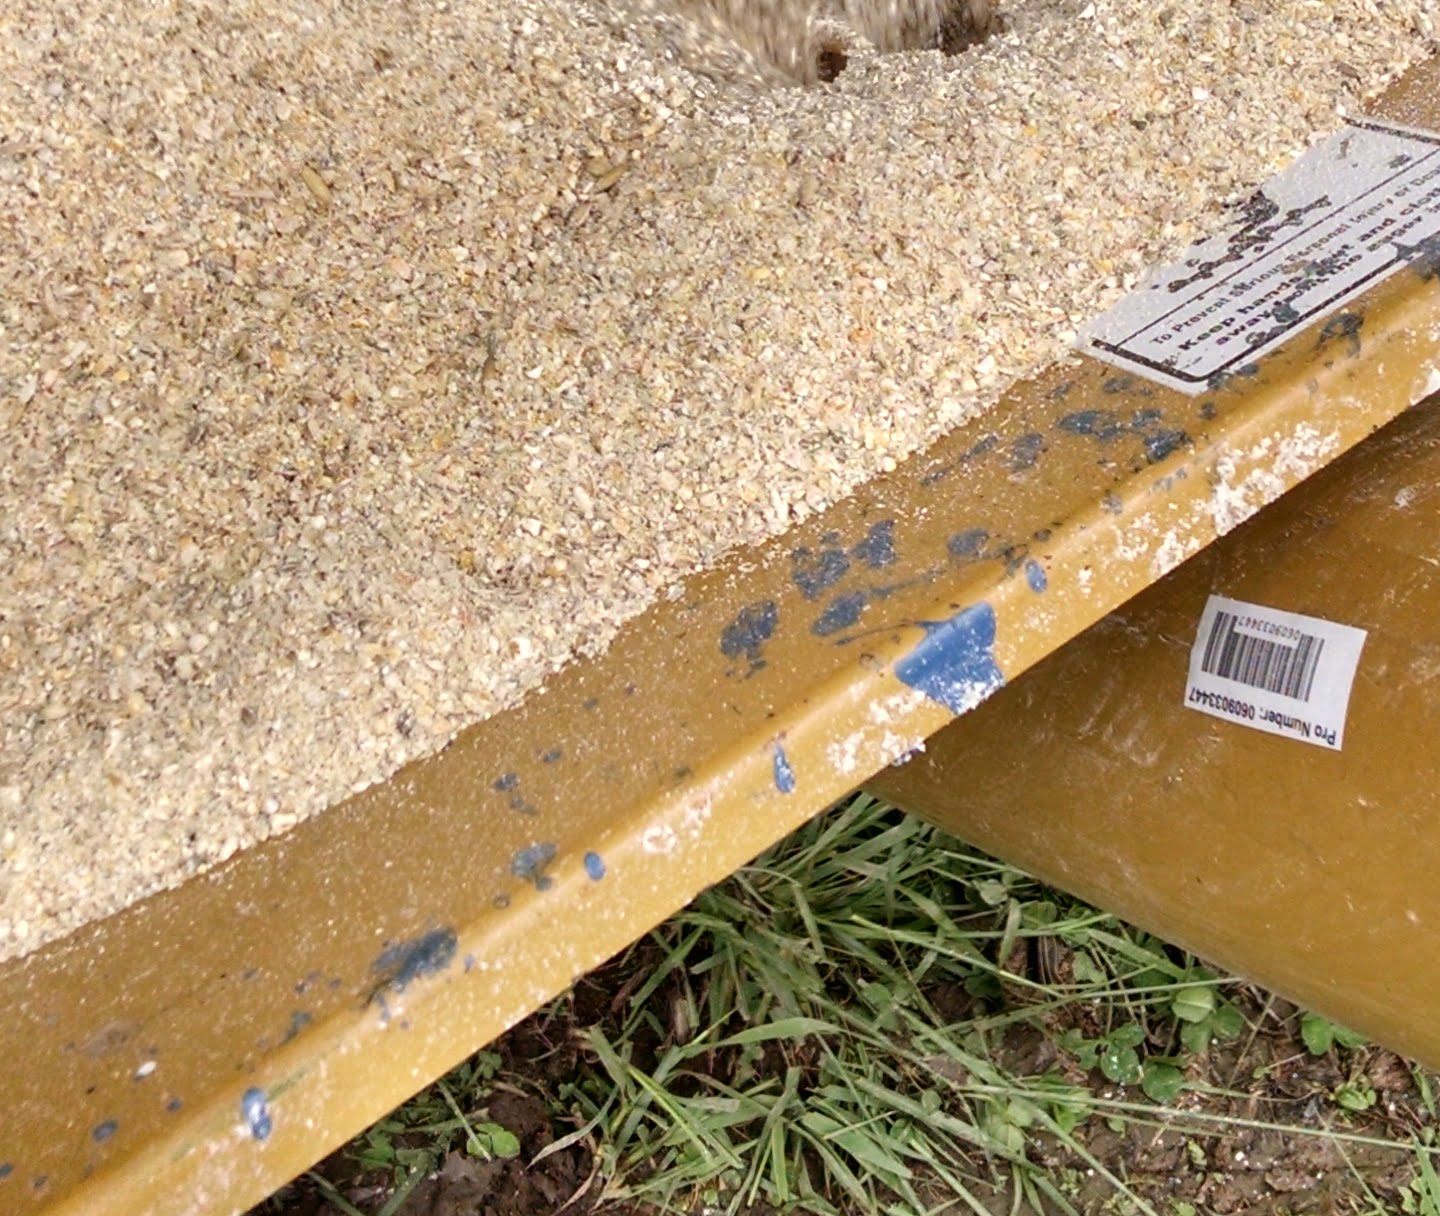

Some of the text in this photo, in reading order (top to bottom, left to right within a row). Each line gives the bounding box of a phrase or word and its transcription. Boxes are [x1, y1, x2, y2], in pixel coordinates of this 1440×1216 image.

[1152, 333, 1173, 345] To
[1172, 297, 1231, 333] Prevent
[1285, 223, 1351, 262] Personal
[1349, 197, 1394, 224] Injury
[1178, 316, 1236, 351] Keep
[1357, 217, 1398, 242] and
[1215, 309, 1272, 346] away
[1366, 215, 1423, 252] auger
[1237, 615, 1302, 642] 0609033447
[1188, 686, 1338, 747] Pro Number: 0609033447
